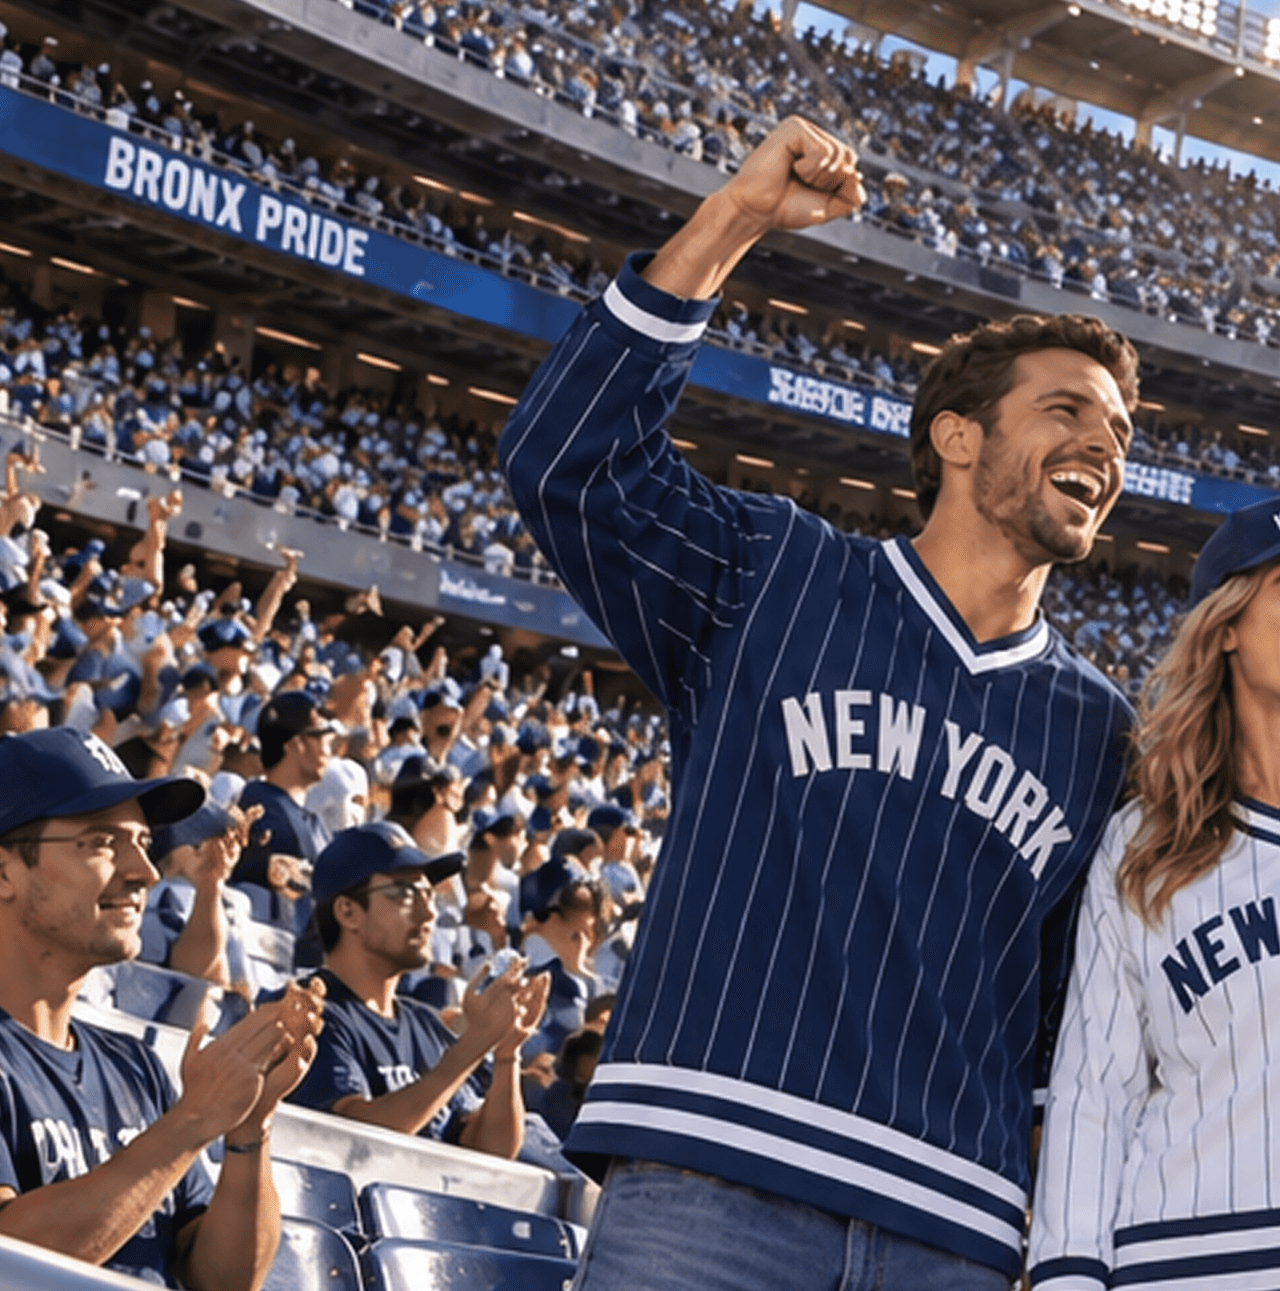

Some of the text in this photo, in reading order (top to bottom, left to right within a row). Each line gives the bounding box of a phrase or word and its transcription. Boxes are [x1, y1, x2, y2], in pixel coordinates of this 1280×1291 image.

[104, 136, 369, 276] BRONX PRIDE
[781, 689, 1073, 881] NEW YORK
